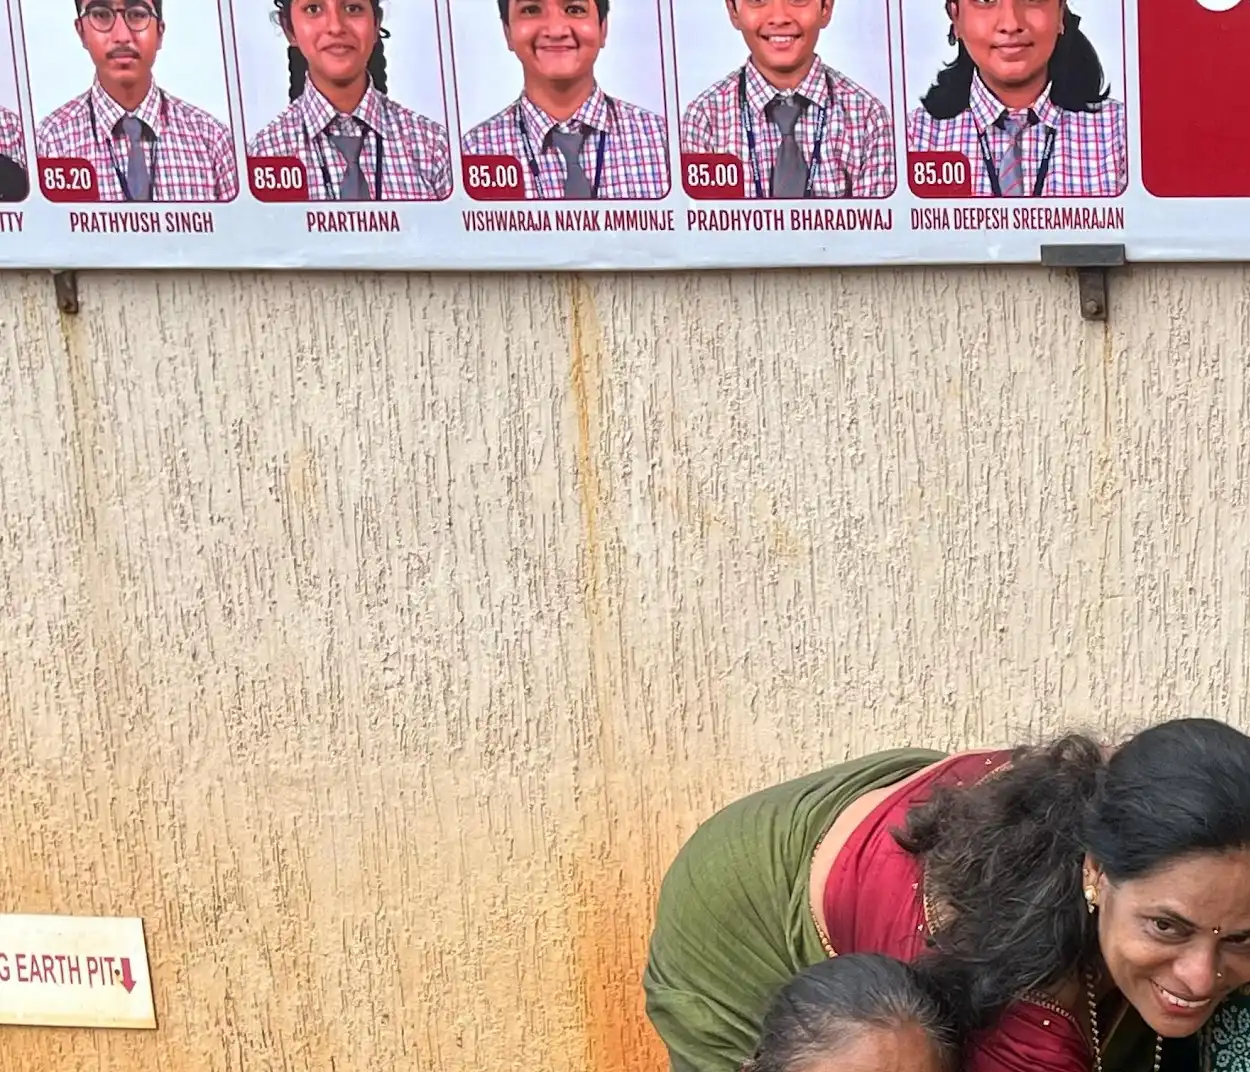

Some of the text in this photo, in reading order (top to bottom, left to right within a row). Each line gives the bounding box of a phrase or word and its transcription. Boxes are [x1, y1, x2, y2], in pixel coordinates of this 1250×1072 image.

[44, 166, 92, 190] 85.20
[253, 165, 303, 189] 85.00
[468, 164, 518, 188] 85.00
[687, 163, 738, 187] 85.00
[913, 161, 965, 185] 85.00
[69, 211, 214, 233] PRATHYUSH SINGH
[306, 210, 401, 233] PRARTHANA
[462, 209, 675, 232] VISHWARAJA NAYAK AMMUNJE
[687, 208, 893, 231] PRADHYOTH BHARADWAJ
[910, 207, 1125, 230] DISHA DEEPESH SREERAMARAJAN
[15, 953, 82, 985] EARTH
[86, 956, 116, 988] PIT
